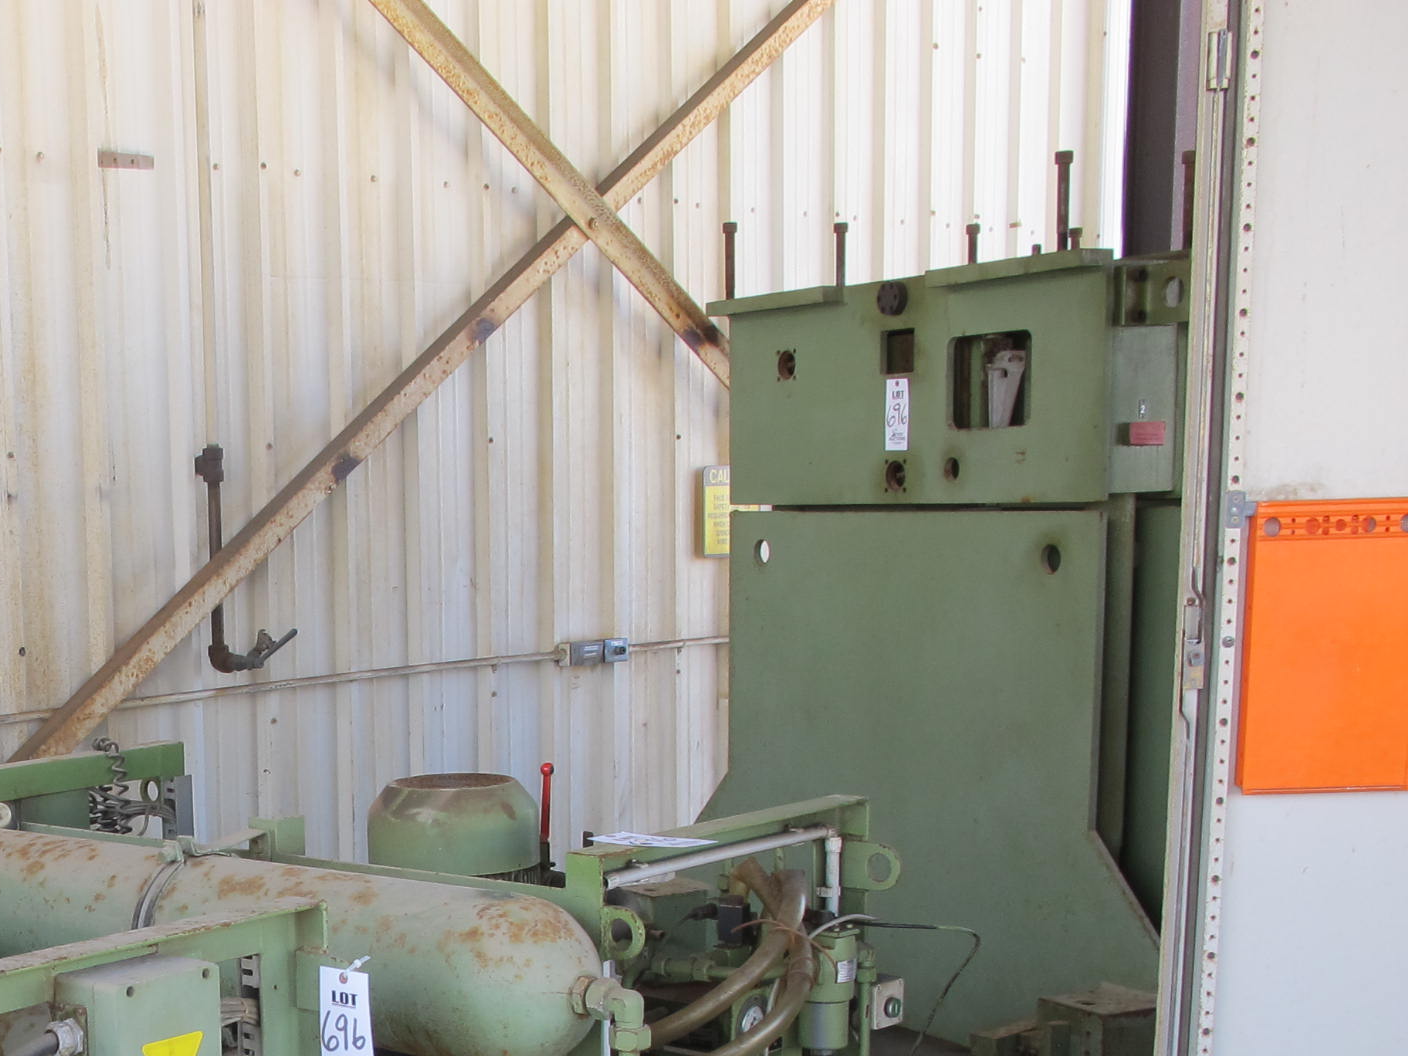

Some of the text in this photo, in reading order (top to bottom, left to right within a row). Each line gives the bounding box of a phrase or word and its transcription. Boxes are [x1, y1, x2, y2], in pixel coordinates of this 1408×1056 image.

[892, 390, 904, 400] LOT
[887, 403, 907, 427] 696
[331, 990, 358, 1006] LOT
[321, 1010, 366, 1052] 696
